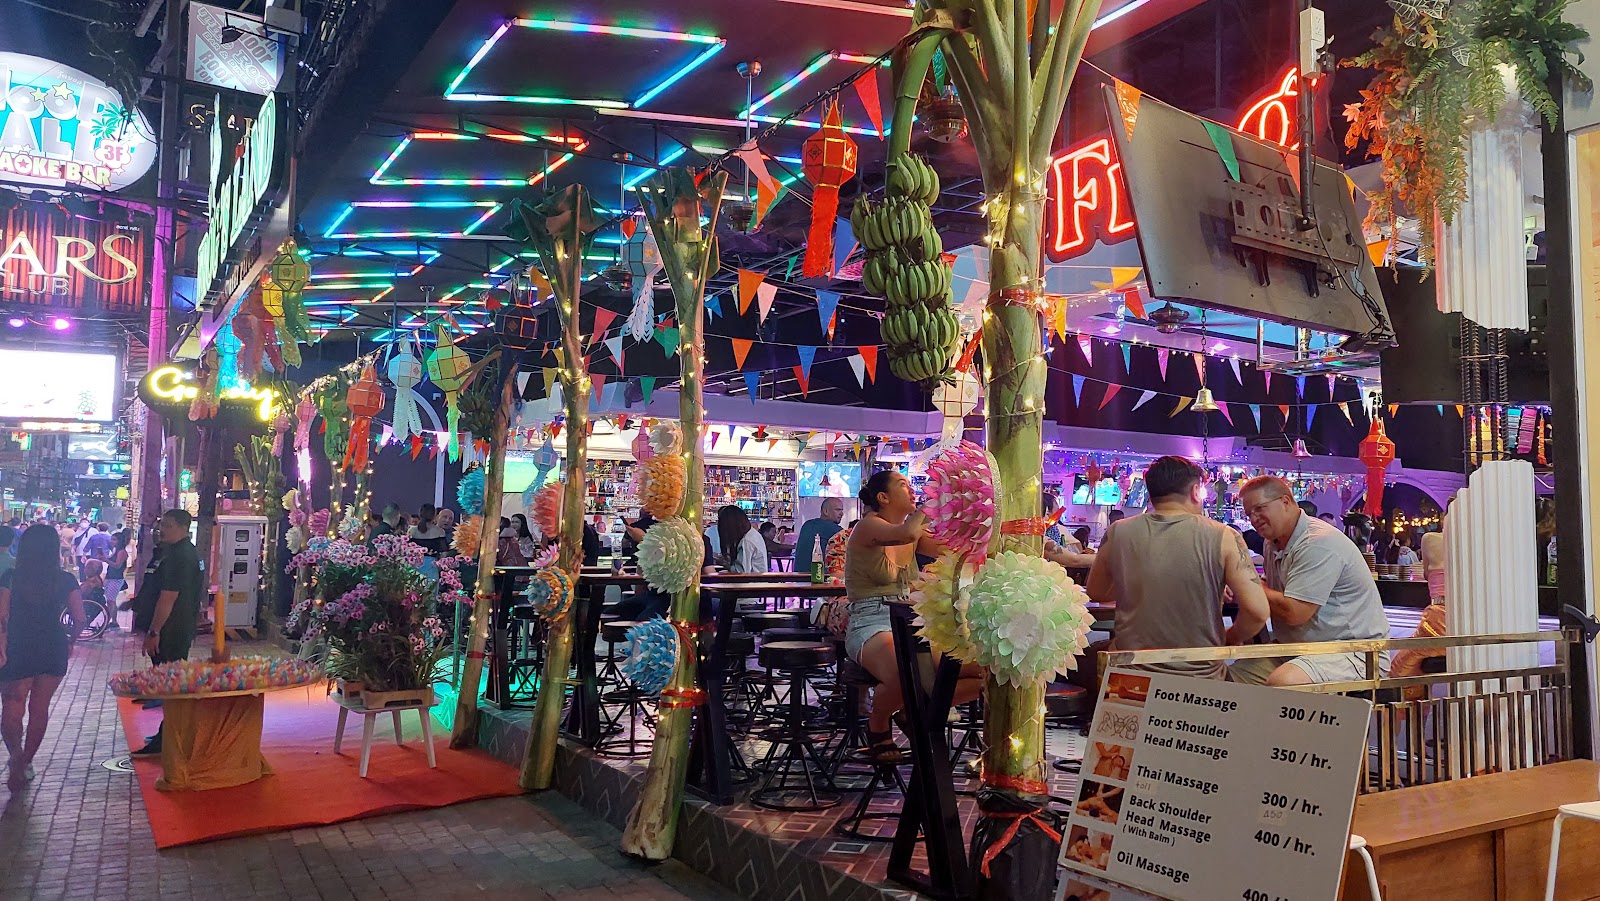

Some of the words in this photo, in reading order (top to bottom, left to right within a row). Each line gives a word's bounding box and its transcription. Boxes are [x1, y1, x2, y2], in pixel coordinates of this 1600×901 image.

[103, 145, 124, 162] 3F
[65, 161, 111, 187] BAR
[815, 563, 823, 581] Chang
[1154, 688, 1180, 702] Foot
[1182, 692, 1238, 713] Massage
[1148, 715, 1174, 730] Foot
[1175, 720, 1230, 739] Shoulder
[1279, 706, 1305, 721] 300
[1308, 710, 1317, 723] /
[1319, 710, 1341, 727] hr.
[1144, 733, 1173, 749] Head
[1175, 739, 1229, 761] Massage
[1270, 747, 1297, 764] 350
[1300, 752, 1309, 766] /
[1310, 753, 1333, 771] hr.
[1137, 765, 1163, 781] Thai
[1164, 771, 1219, 794] Massage
[1129, 795, 1157, 812] Back
[1158, 801, 1213, 825] Shoulder
[1261, 792, 1288, 809] 300
[1291, 798, 1300, 811] /
[1301, 799, 1324, 817] hr.
[1125, 810, 1156, 828] Head
[1159, 818, 1212, 844] Massage
[1127, 826, 1148, 839] With
[1148, 830, 1171, 845] Balm
[1254, 829, 1281, 848] 400
[1283, 836, 1292, 850] /
[1293, 836, 1317, 857] hr.
[1117, 850, 1134, 866] Oil
[1135, 856, 1190, 883] Massage
